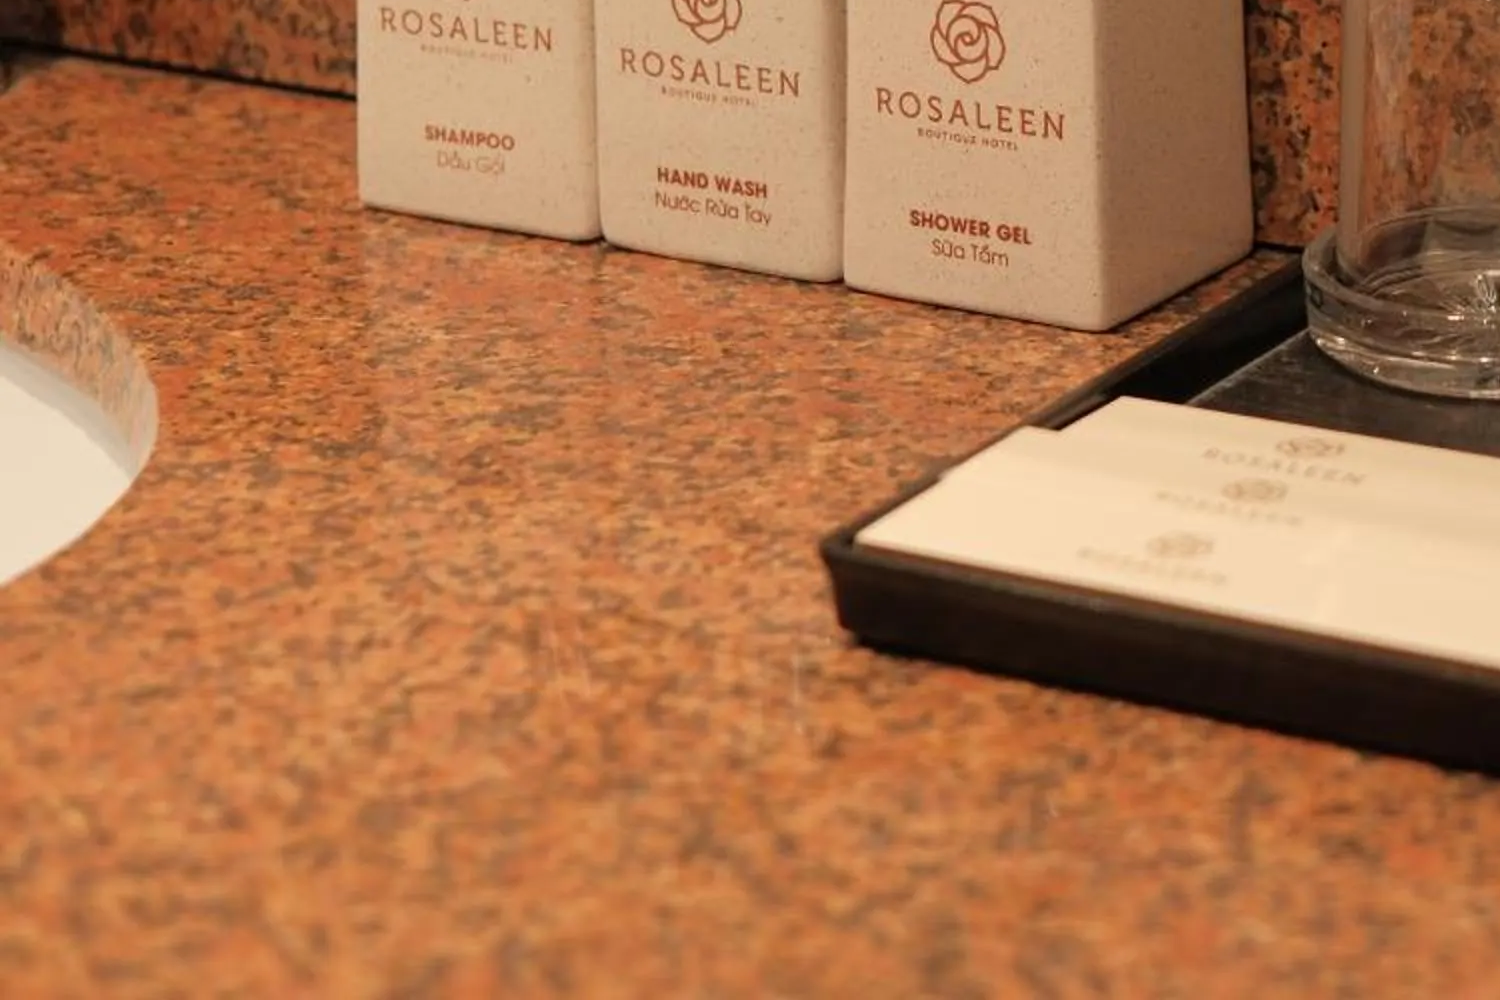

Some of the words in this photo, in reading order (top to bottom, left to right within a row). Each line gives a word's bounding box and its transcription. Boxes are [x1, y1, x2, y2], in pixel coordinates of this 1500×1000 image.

[379, 7, 553, 52] ROSALEEN
[620, 48, 801, 97] ROSALEEN
[876, 87, 1065, 140] ROSALEEN
[425, 124, 515, 151] SHAMPOO
[917, 127, 977, 145] BOUTIQUE
[981, 137, 1019, 151] HOTEL
[656, 167, 709, 189] HAND
[714, 175, 768, 198] WASH
[745, 202, 772, 227] Tay
[909, 209, 992, 239] SHOWER
[996, 223, 1032, 246] GEL
[1201, 446, 1367, 485] ROSALEEN
